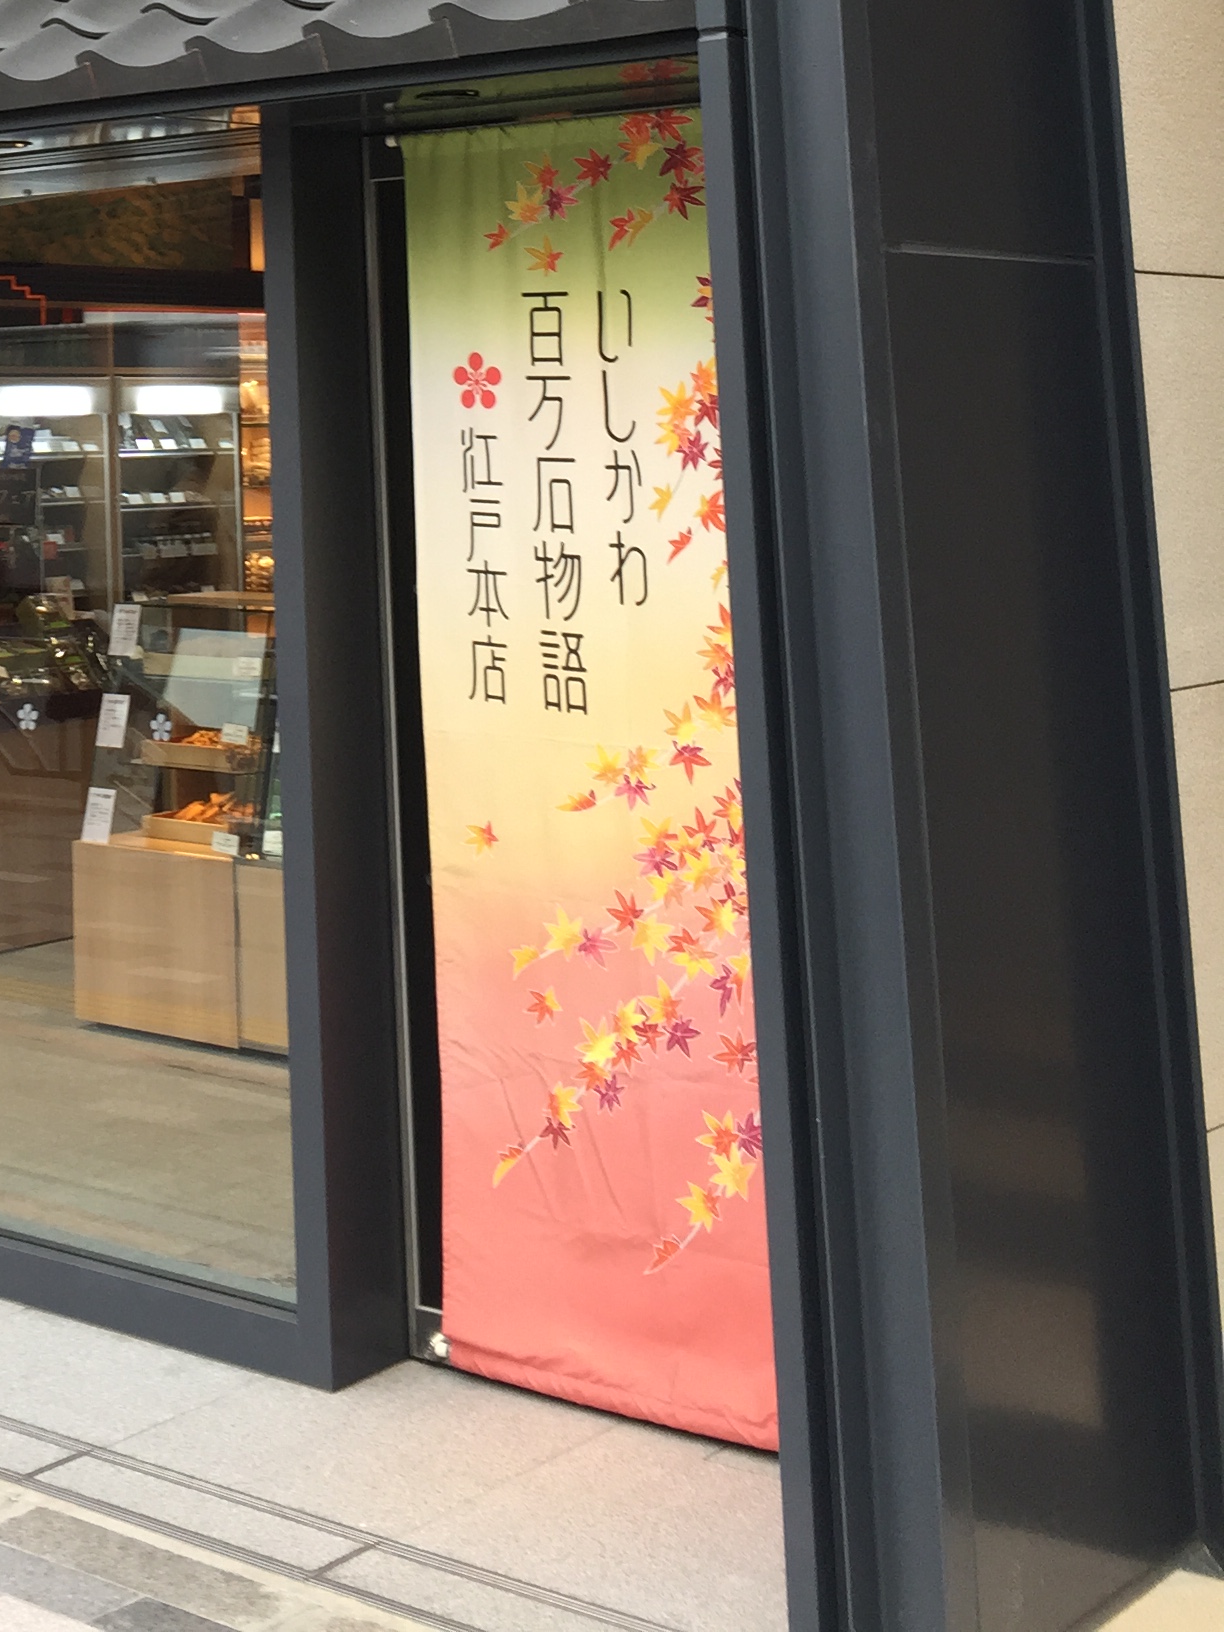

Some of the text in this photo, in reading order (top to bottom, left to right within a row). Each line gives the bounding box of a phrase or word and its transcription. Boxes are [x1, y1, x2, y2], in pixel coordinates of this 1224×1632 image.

[461, 427, 509, 704] 江戸本店
[521, 291, 587, 715] 百万石物語
[597, 289, 648, 606] いしかわ
